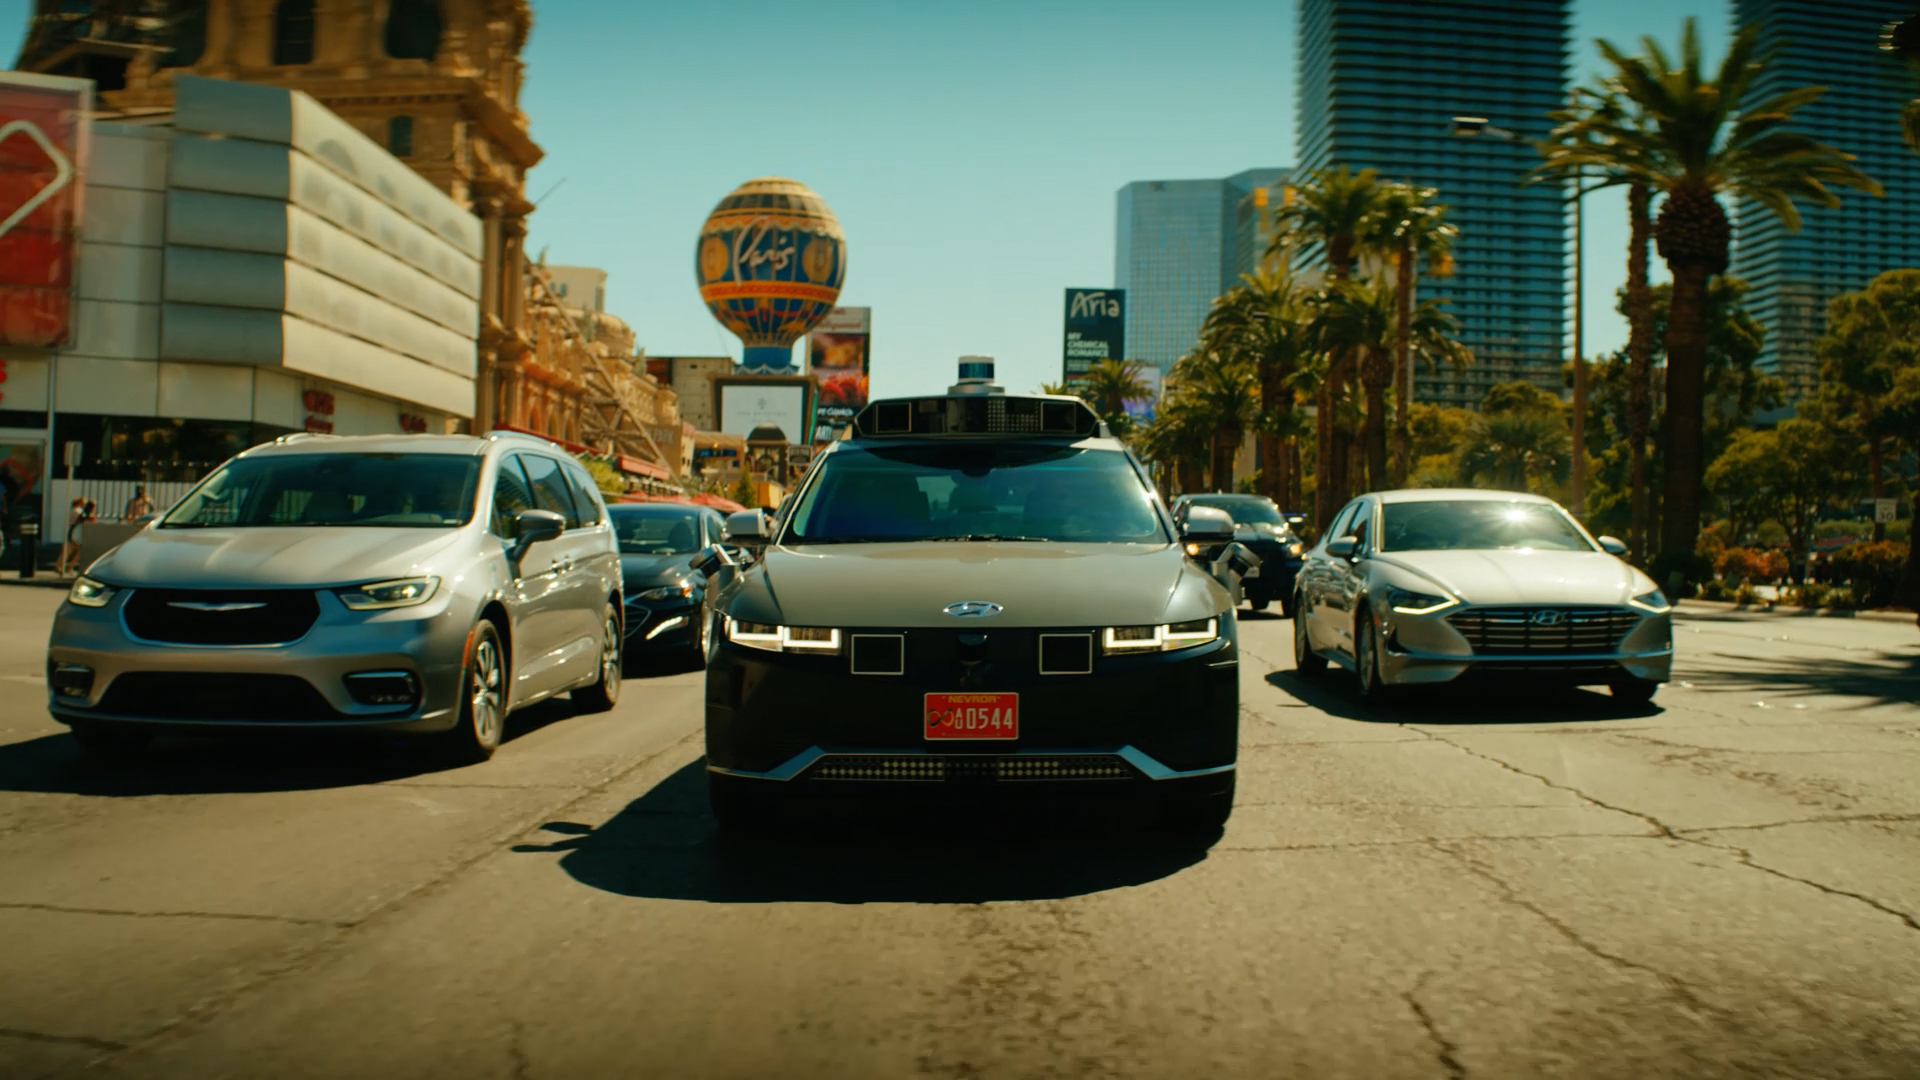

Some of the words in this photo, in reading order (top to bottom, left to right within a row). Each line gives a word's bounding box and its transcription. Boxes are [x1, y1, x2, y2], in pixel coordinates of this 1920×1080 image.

[732, 215, 795, 287] Paris
[1070, 291, 1120, 318] Aria
[1067, 332, 1082, 340] MY
[1067, 341, 1109, 349] CHEMICAL
[1067, 349, 1109, 357] ROMANCE
[948, 695, 997, 704] NEVADA
